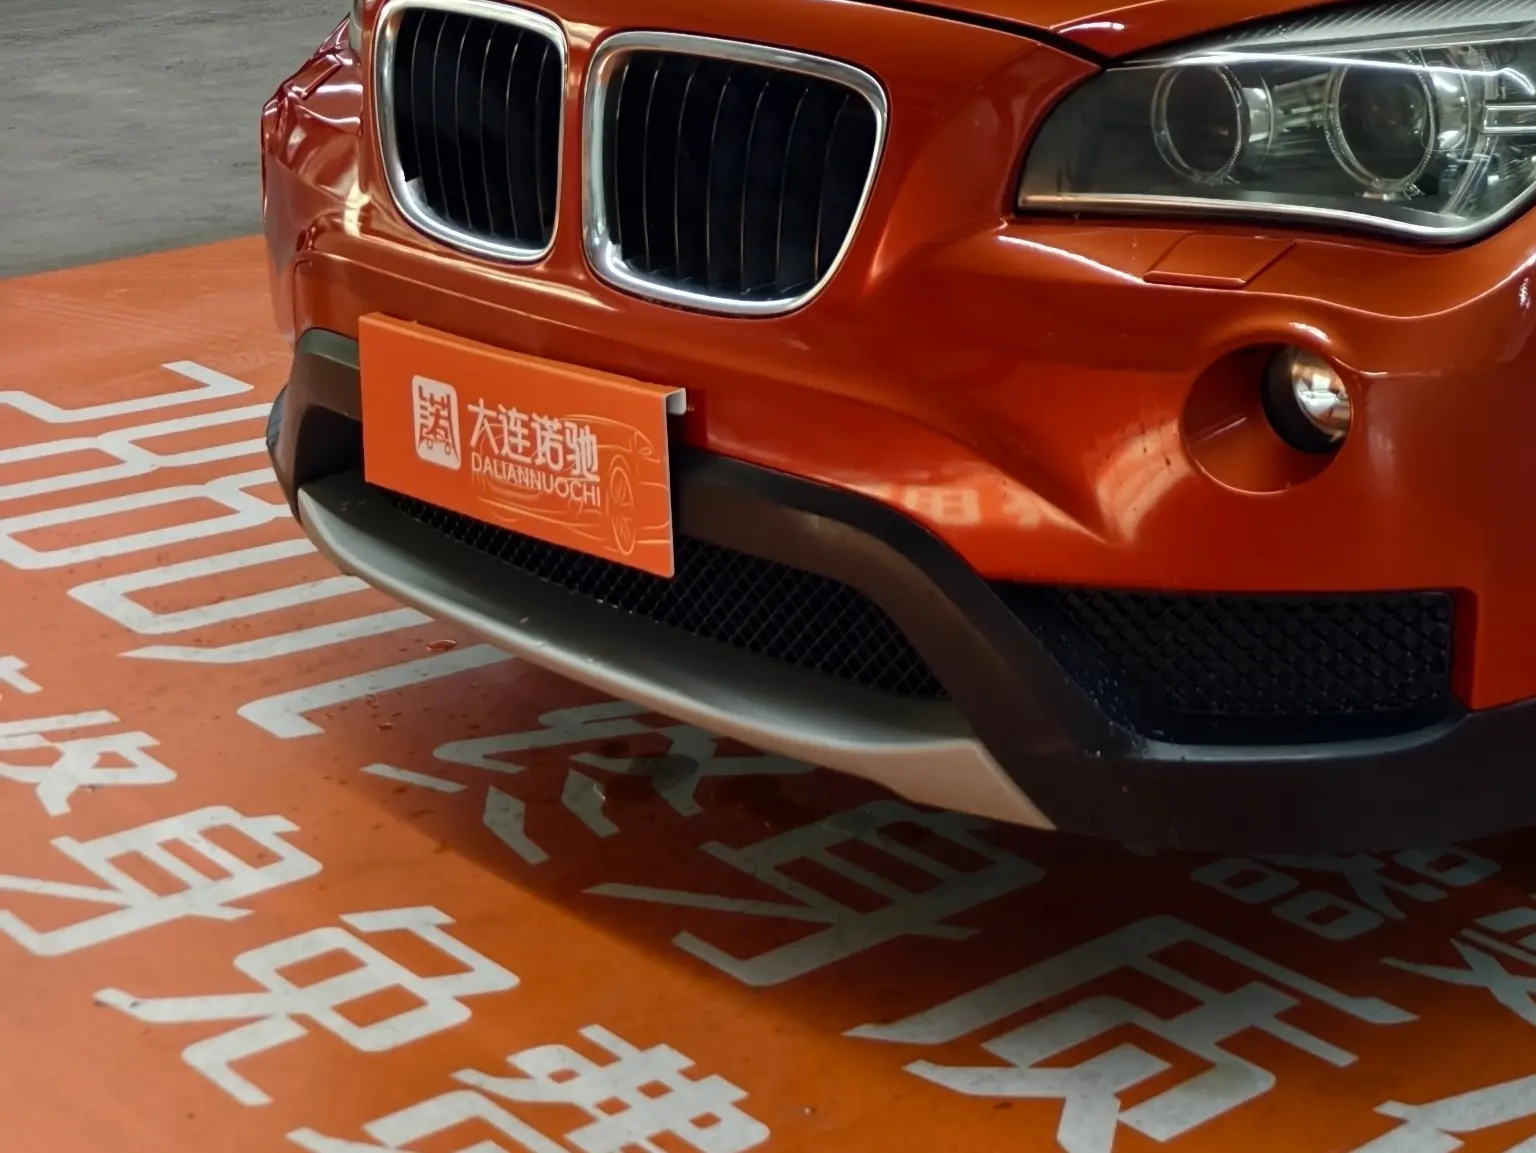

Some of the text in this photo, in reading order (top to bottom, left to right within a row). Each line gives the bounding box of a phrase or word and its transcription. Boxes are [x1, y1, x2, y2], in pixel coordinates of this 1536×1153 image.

[467, 397, 601, 482] 大连诺驰
[470, 452, 601, 508] DALIANNUOCHI
